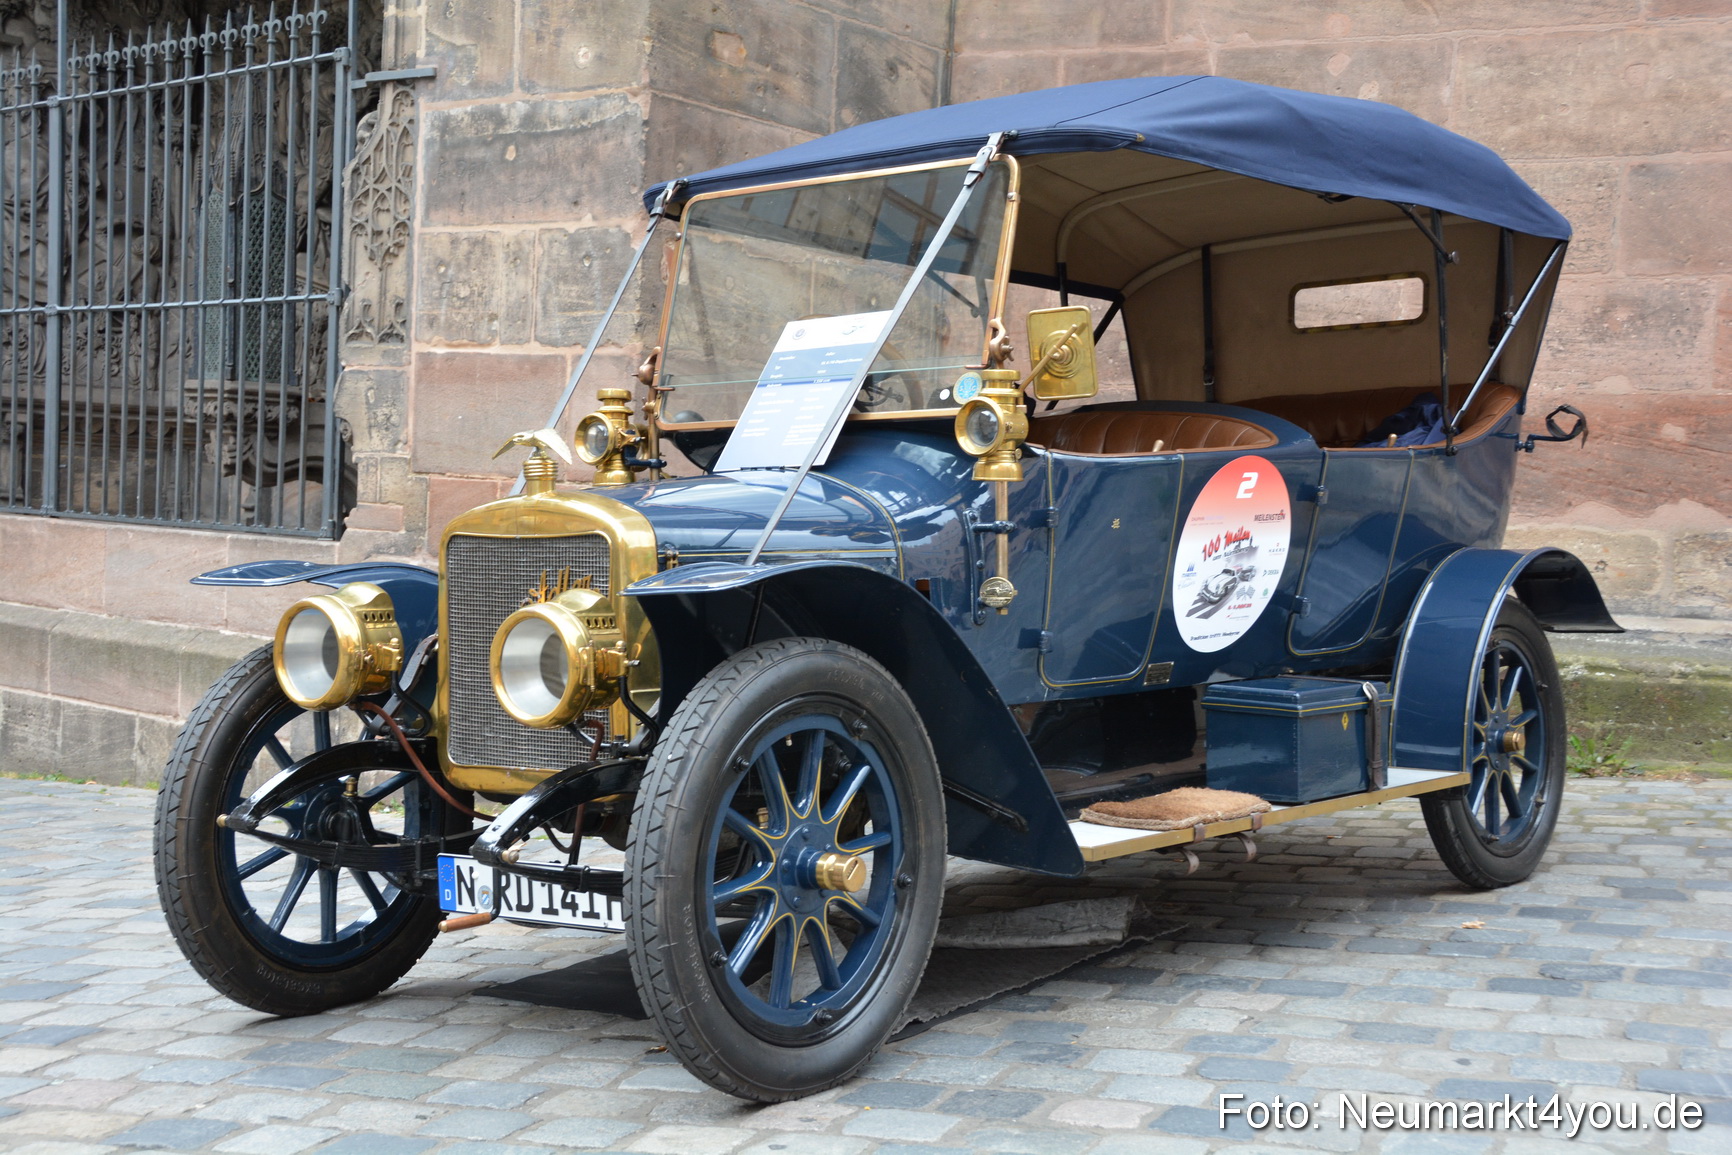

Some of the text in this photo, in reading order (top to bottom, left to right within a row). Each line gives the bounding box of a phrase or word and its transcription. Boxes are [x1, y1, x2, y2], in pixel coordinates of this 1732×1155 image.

[1236, 471, 1259, 499] 2
[1202, 534, 1222, 562] 100
[444, 889, 452, 901] D
[456, 865, 476, 907] N
